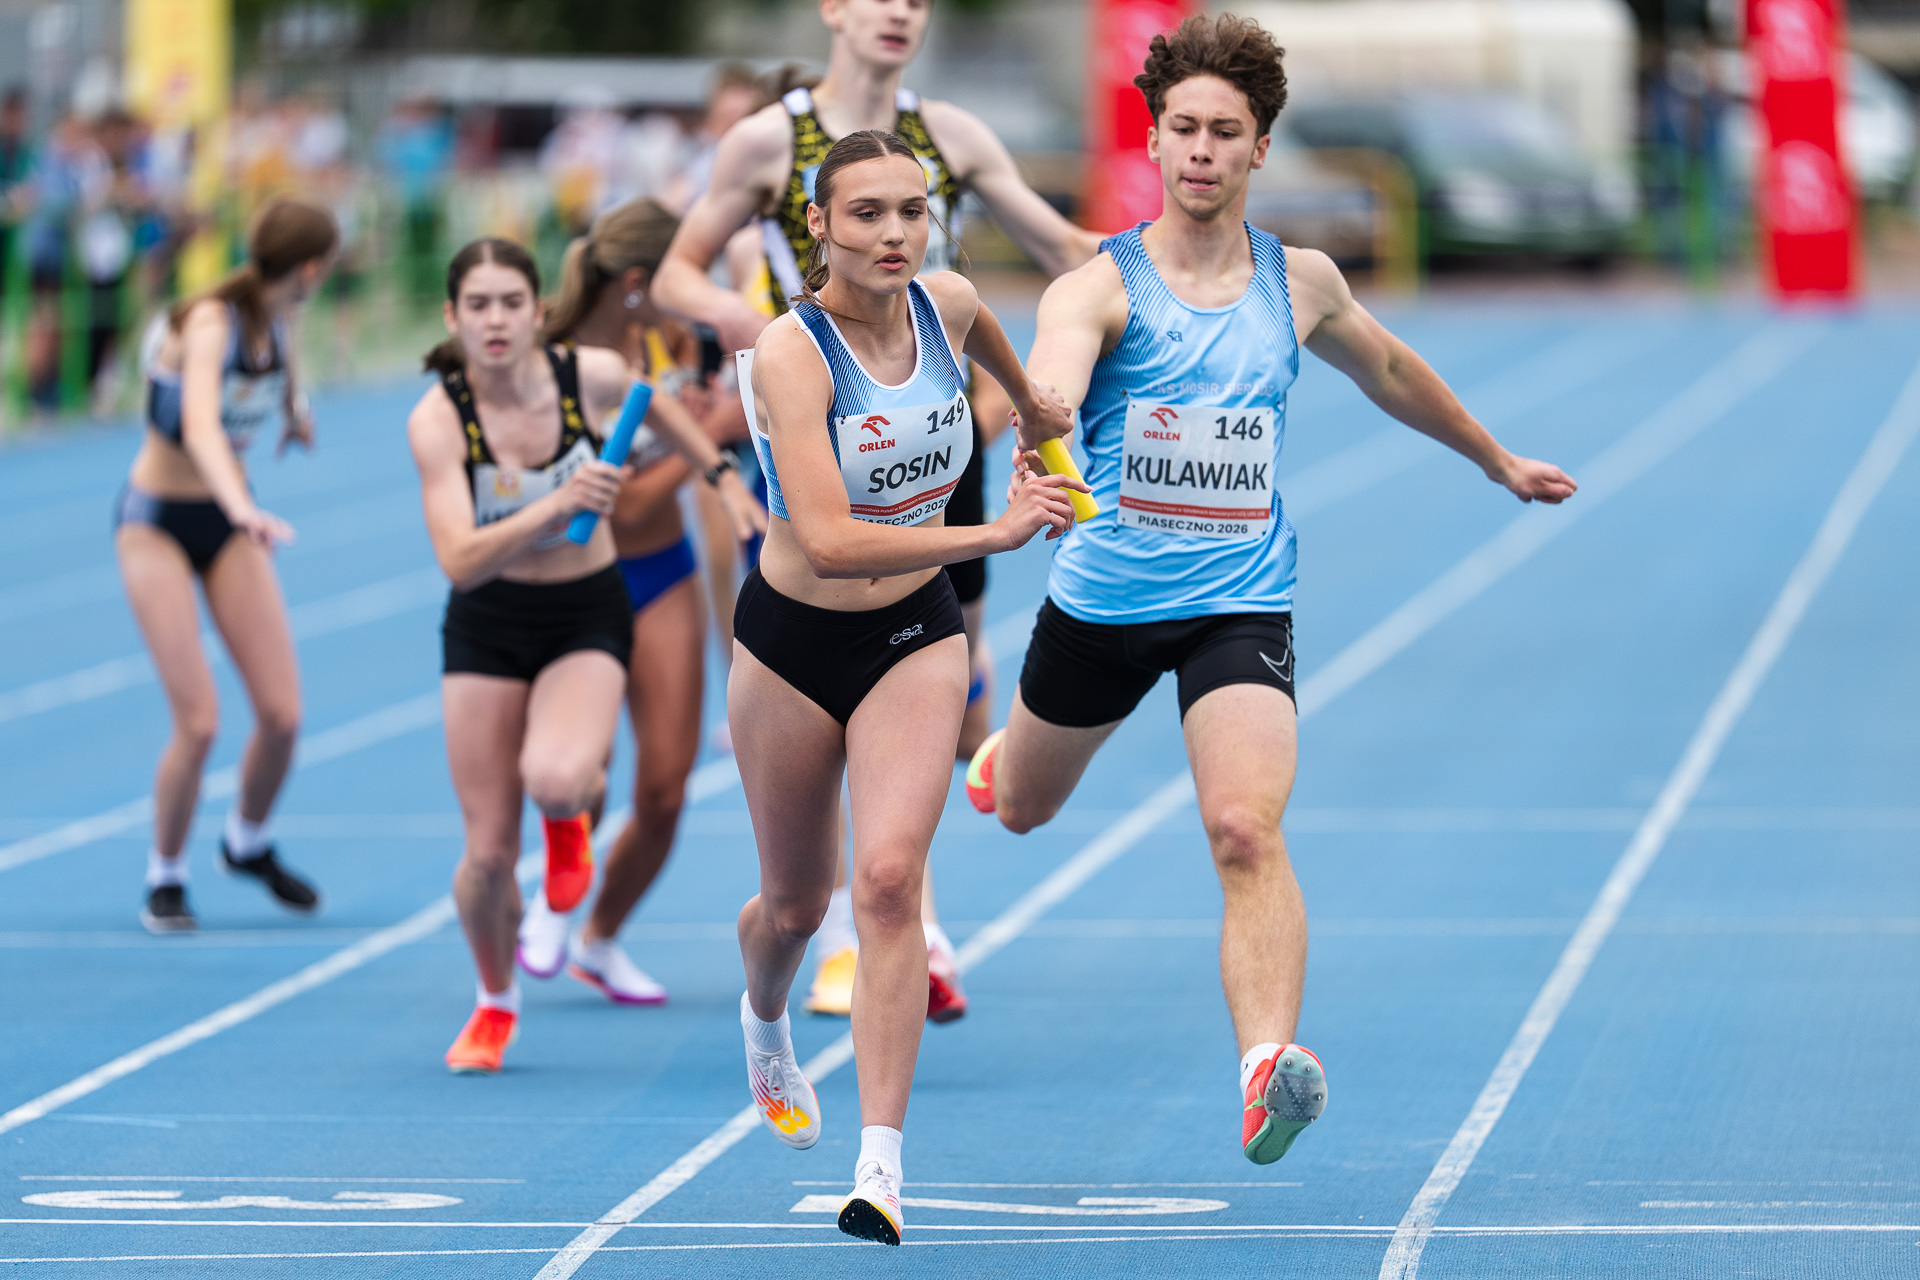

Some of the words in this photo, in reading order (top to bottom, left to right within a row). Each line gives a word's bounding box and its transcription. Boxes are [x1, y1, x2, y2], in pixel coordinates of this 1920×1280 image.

[926, 396, 964, 435] 149
[1143, 430, 1181, 441] ORLEN
[1215, 416, 1263, 441] 146
[858, 438, 896, 453] ORLEN
[867, 445, 952, 494] SOSIN
[1126, 454, 1268, 491] KULAWIAK
[1138, 514, 1214, 533] PIASECZNO
[1217, 523, 1248, 534] 2026
